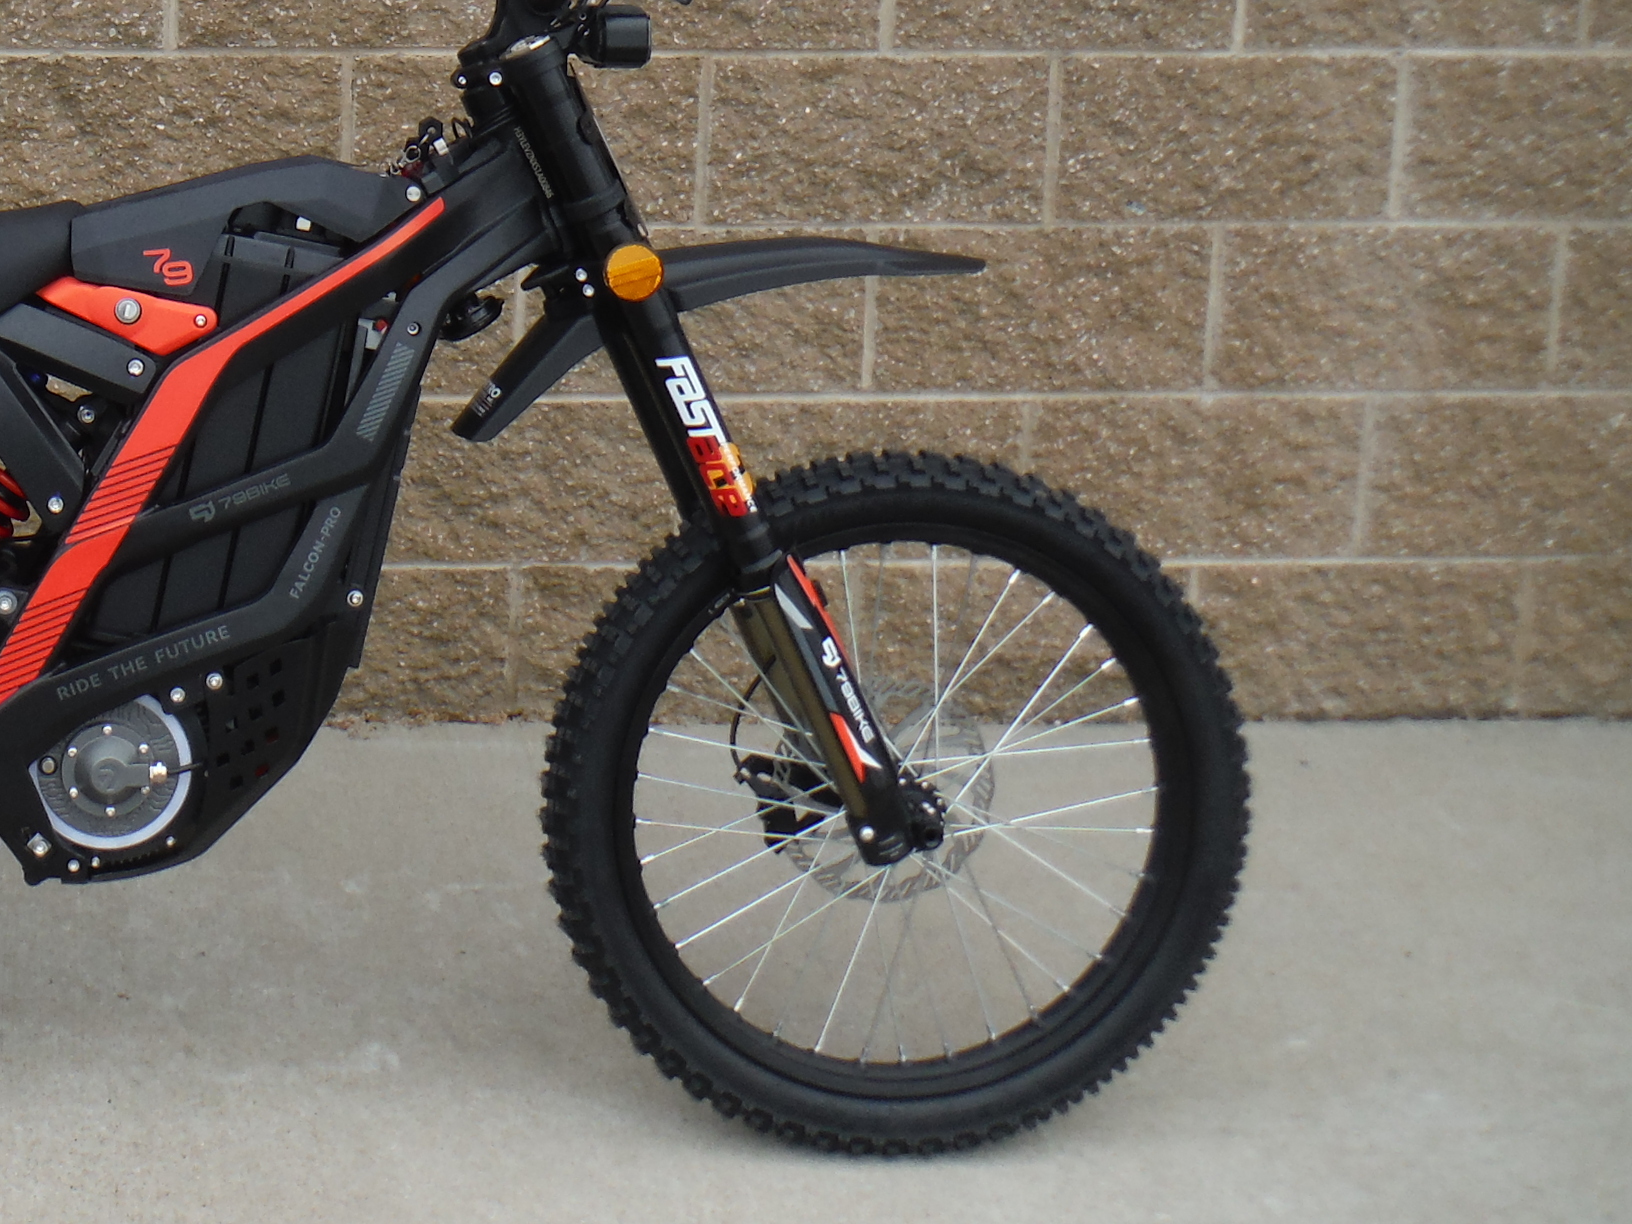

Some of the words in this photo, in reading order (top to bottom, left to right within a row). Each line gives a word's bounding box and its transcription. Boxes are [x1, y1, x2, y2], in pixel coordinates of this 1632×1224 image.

[143, 248, 193, 286] 79
[221, 473, 291, 510] 79BIKE
[289, 506, 341, 599] FALCON-PRO
[56, 672, 102, 701] RIDE
[108, 655, 148, 681] THE
[155, 625, 230, 664] FUTURE
[836, 666, 874, 743] 79BIKE
